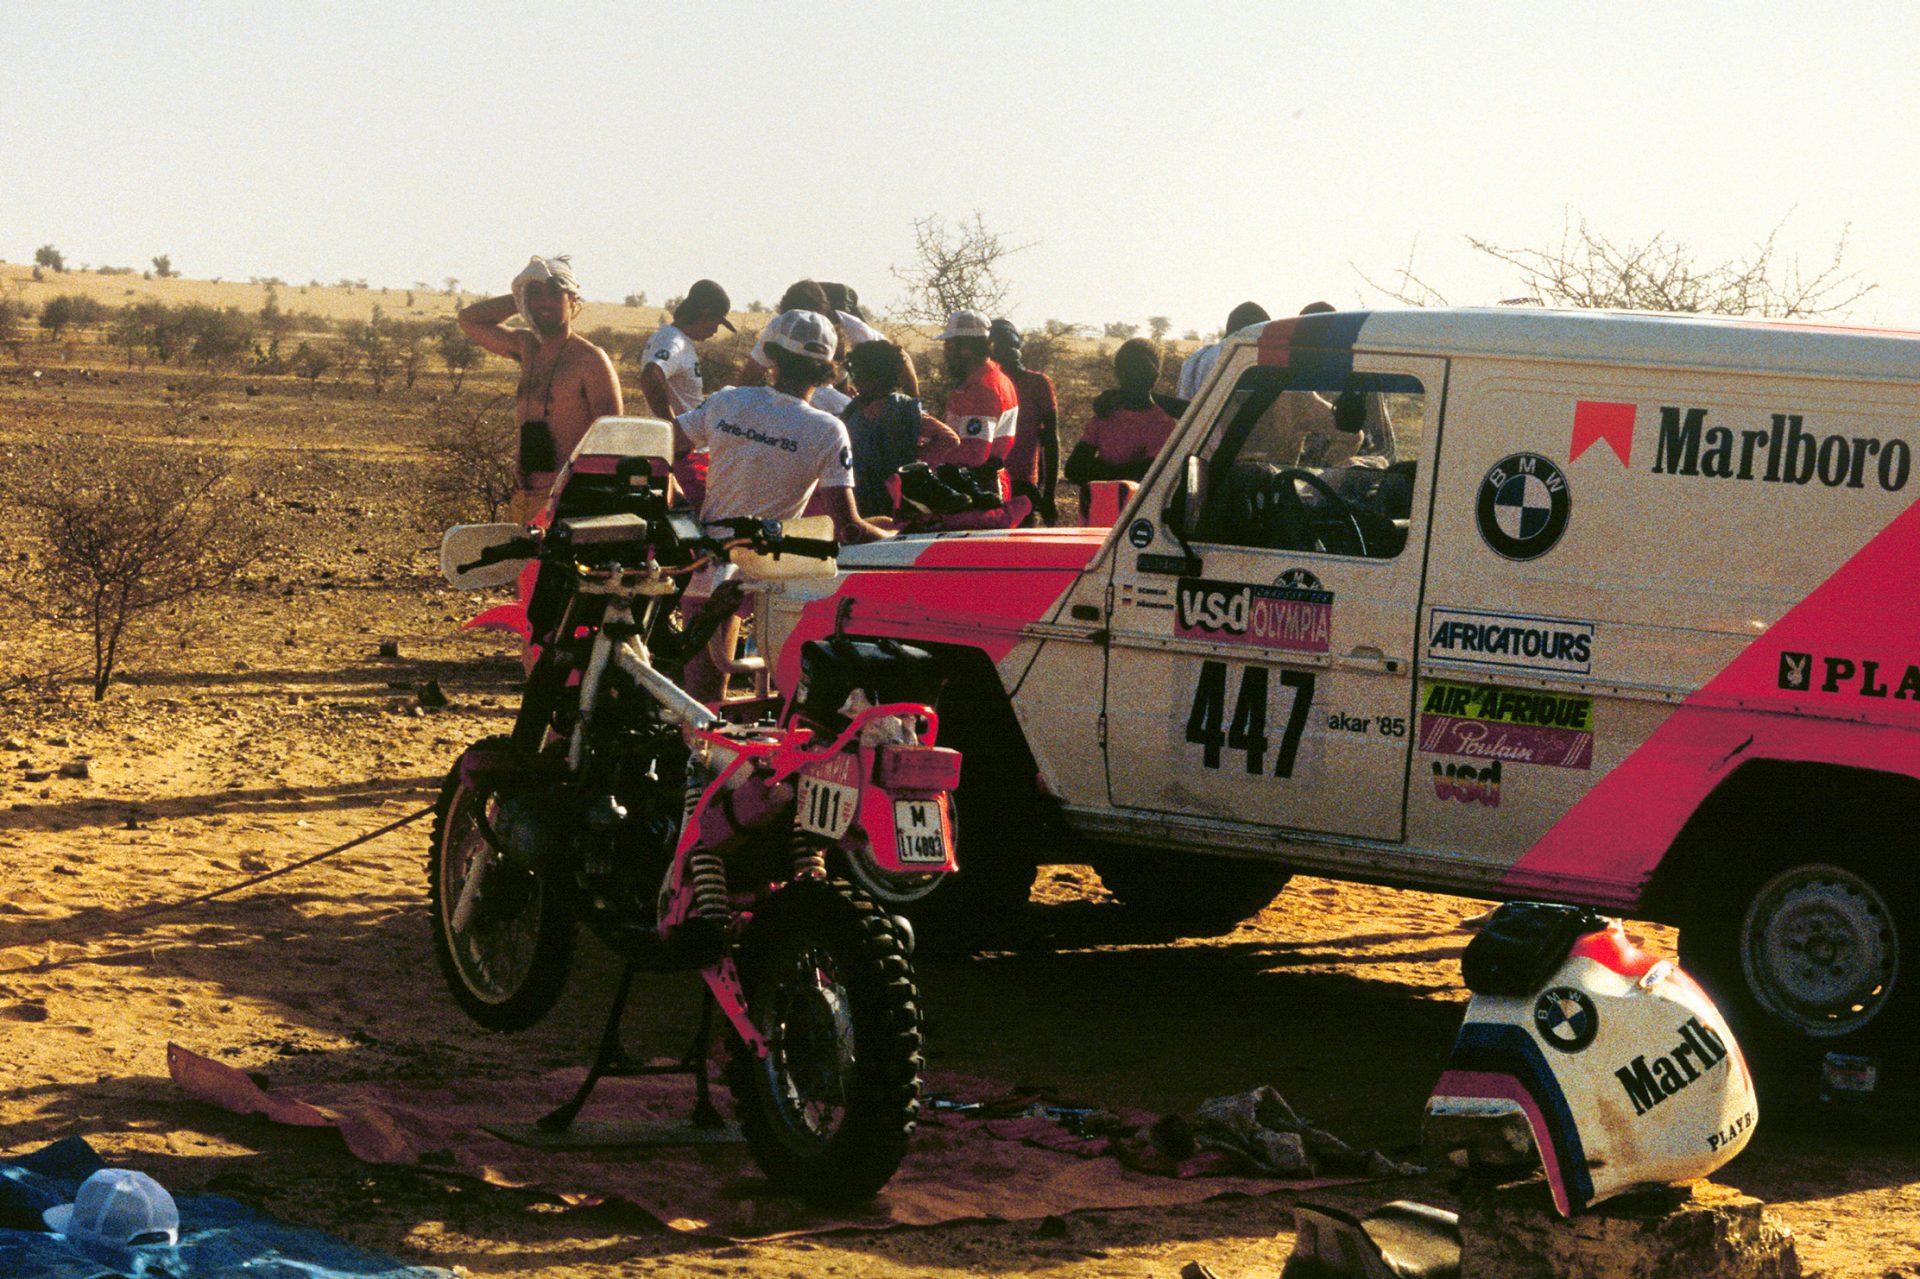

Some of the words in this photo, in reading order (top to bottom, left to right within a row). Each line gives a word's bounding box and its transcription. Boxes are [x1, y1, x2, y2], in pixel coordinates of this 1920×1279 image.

[1652, 406, 1911, 492] Marlboro
[1252, 601, 1330, 643] OLYMPIA
[1430, 621, 1592, 663] AFRICATOURS
[1821, 656, 1920, 702] PLA
[1186, 660, 1316, 779] 447
[1327, 711, 1371, 733] akar
[1375, 716, 1406, 737] '85
[1424, 684, 1472, 716] AIR
[1477, 687, 1591, 728] AFRIQUE
[1452, 720, 1534, 761] Poulain
[809, 784, 841, 832] 101
[910, 805, 926, 827] M
[1706, 1106, 1755, 1152] PLAYB
